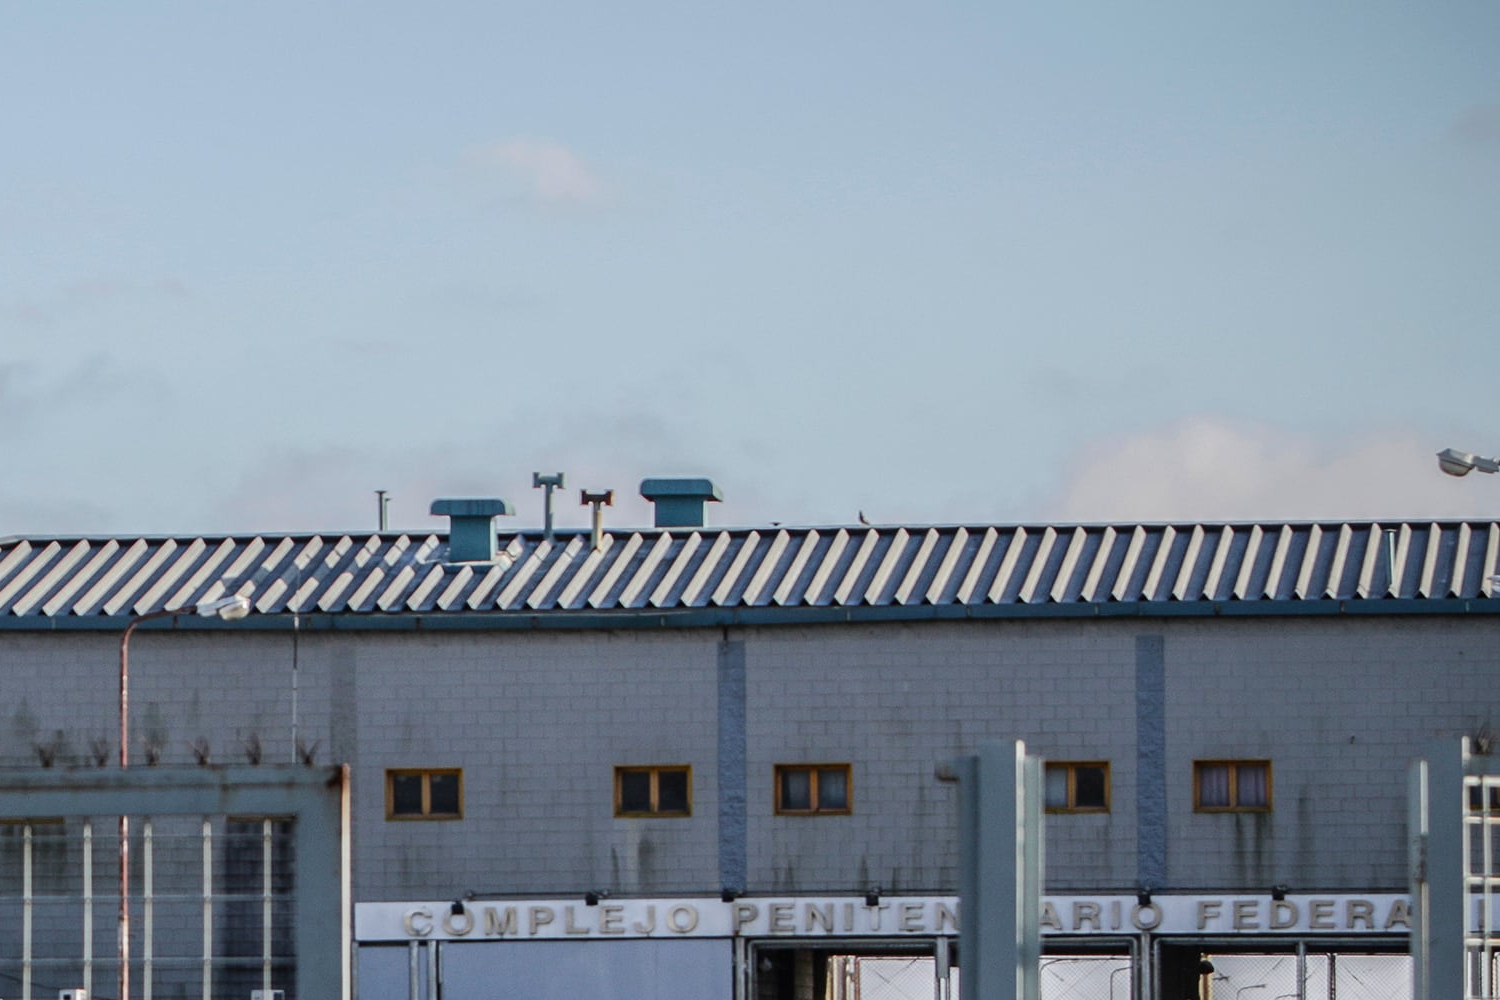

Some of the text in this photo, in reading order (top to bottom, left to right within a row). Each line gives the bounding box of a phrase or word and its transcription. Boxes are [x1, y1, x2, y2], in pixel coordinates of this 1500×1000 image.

[403, 904, 699, 937] COMPLEJO
[733, 901, 1163, 934] PENITENARIO
[1197, 899, 1413, 930] FEDERA
